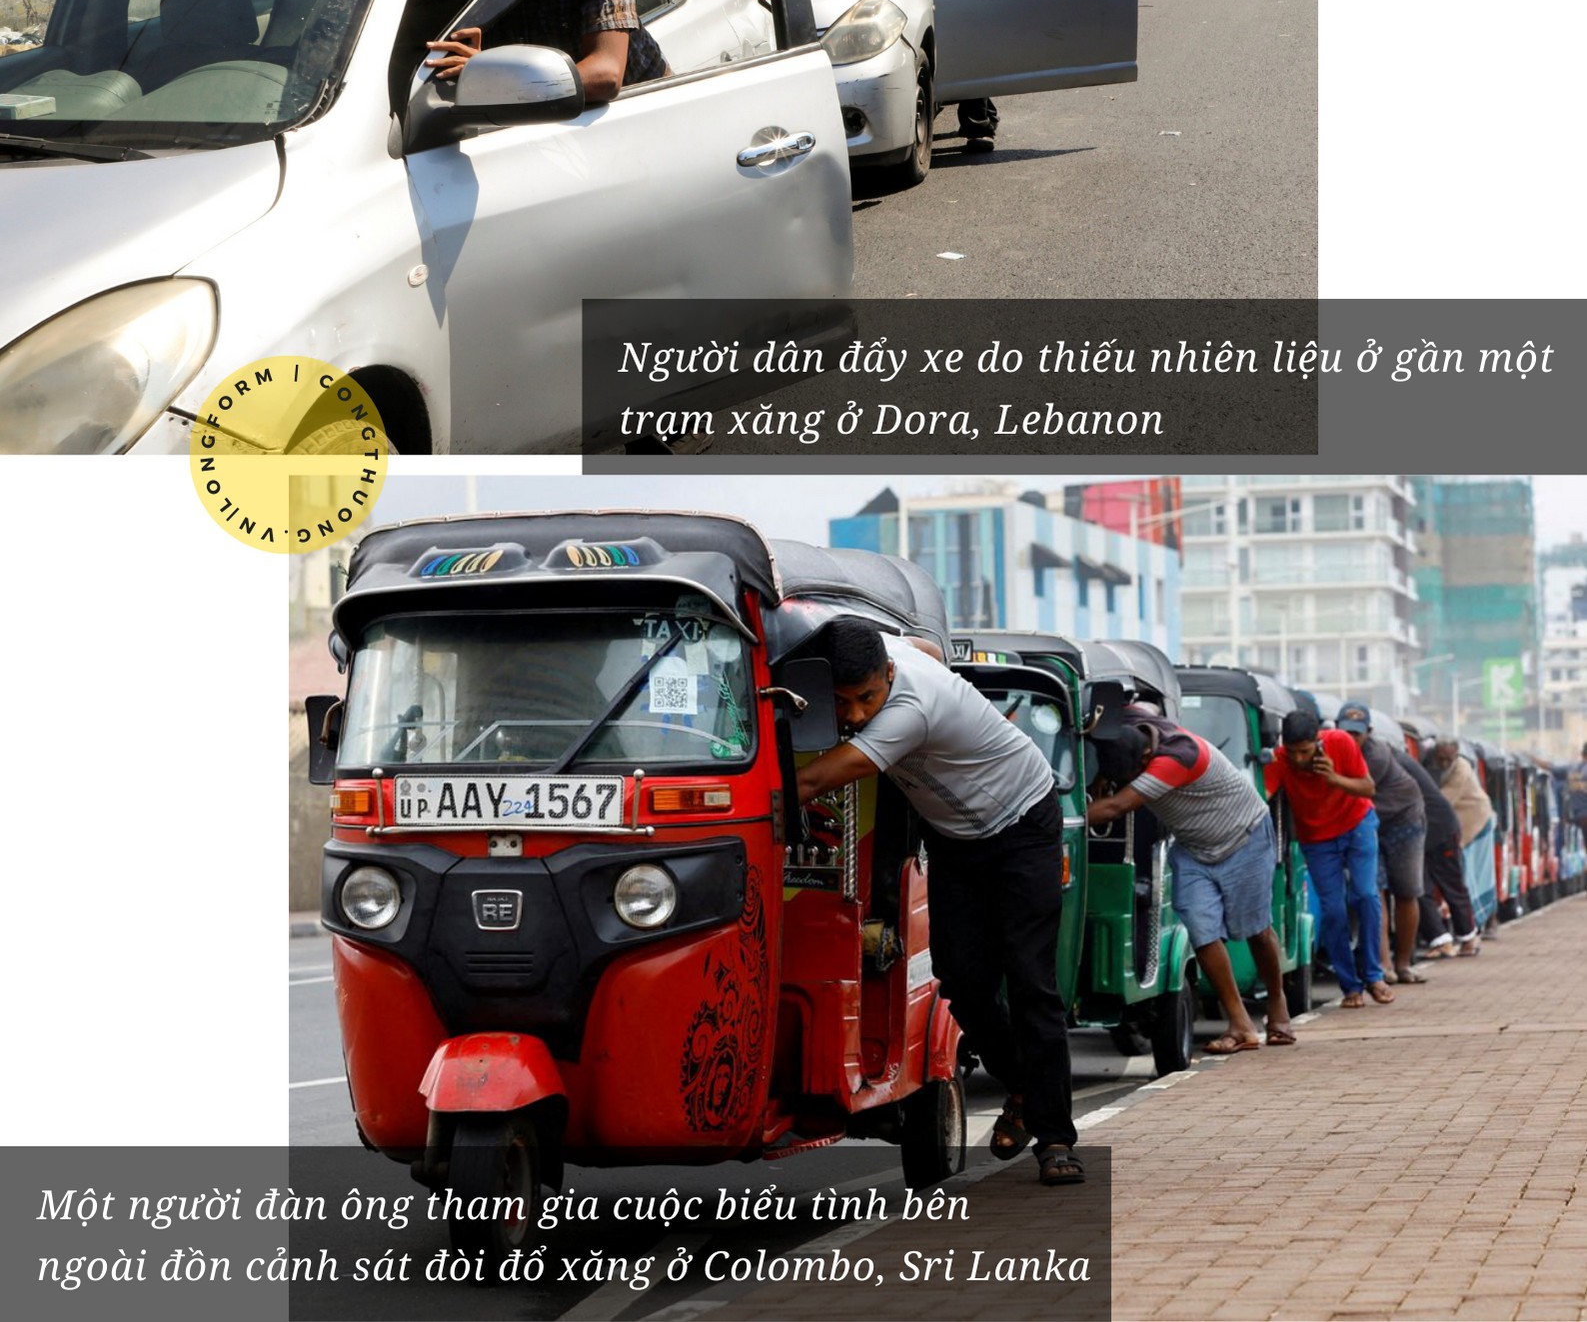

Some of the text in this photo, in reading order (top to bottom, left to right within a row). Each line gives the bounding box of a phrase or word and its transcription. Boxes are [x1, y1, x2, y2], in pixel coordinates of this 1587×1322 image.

[644, 619, 699, 640] TAXI
[952, 645, 965, 658] XI
[436, 783, 617, 819] AAY 1567
[482, 903, 513, 921] RE
